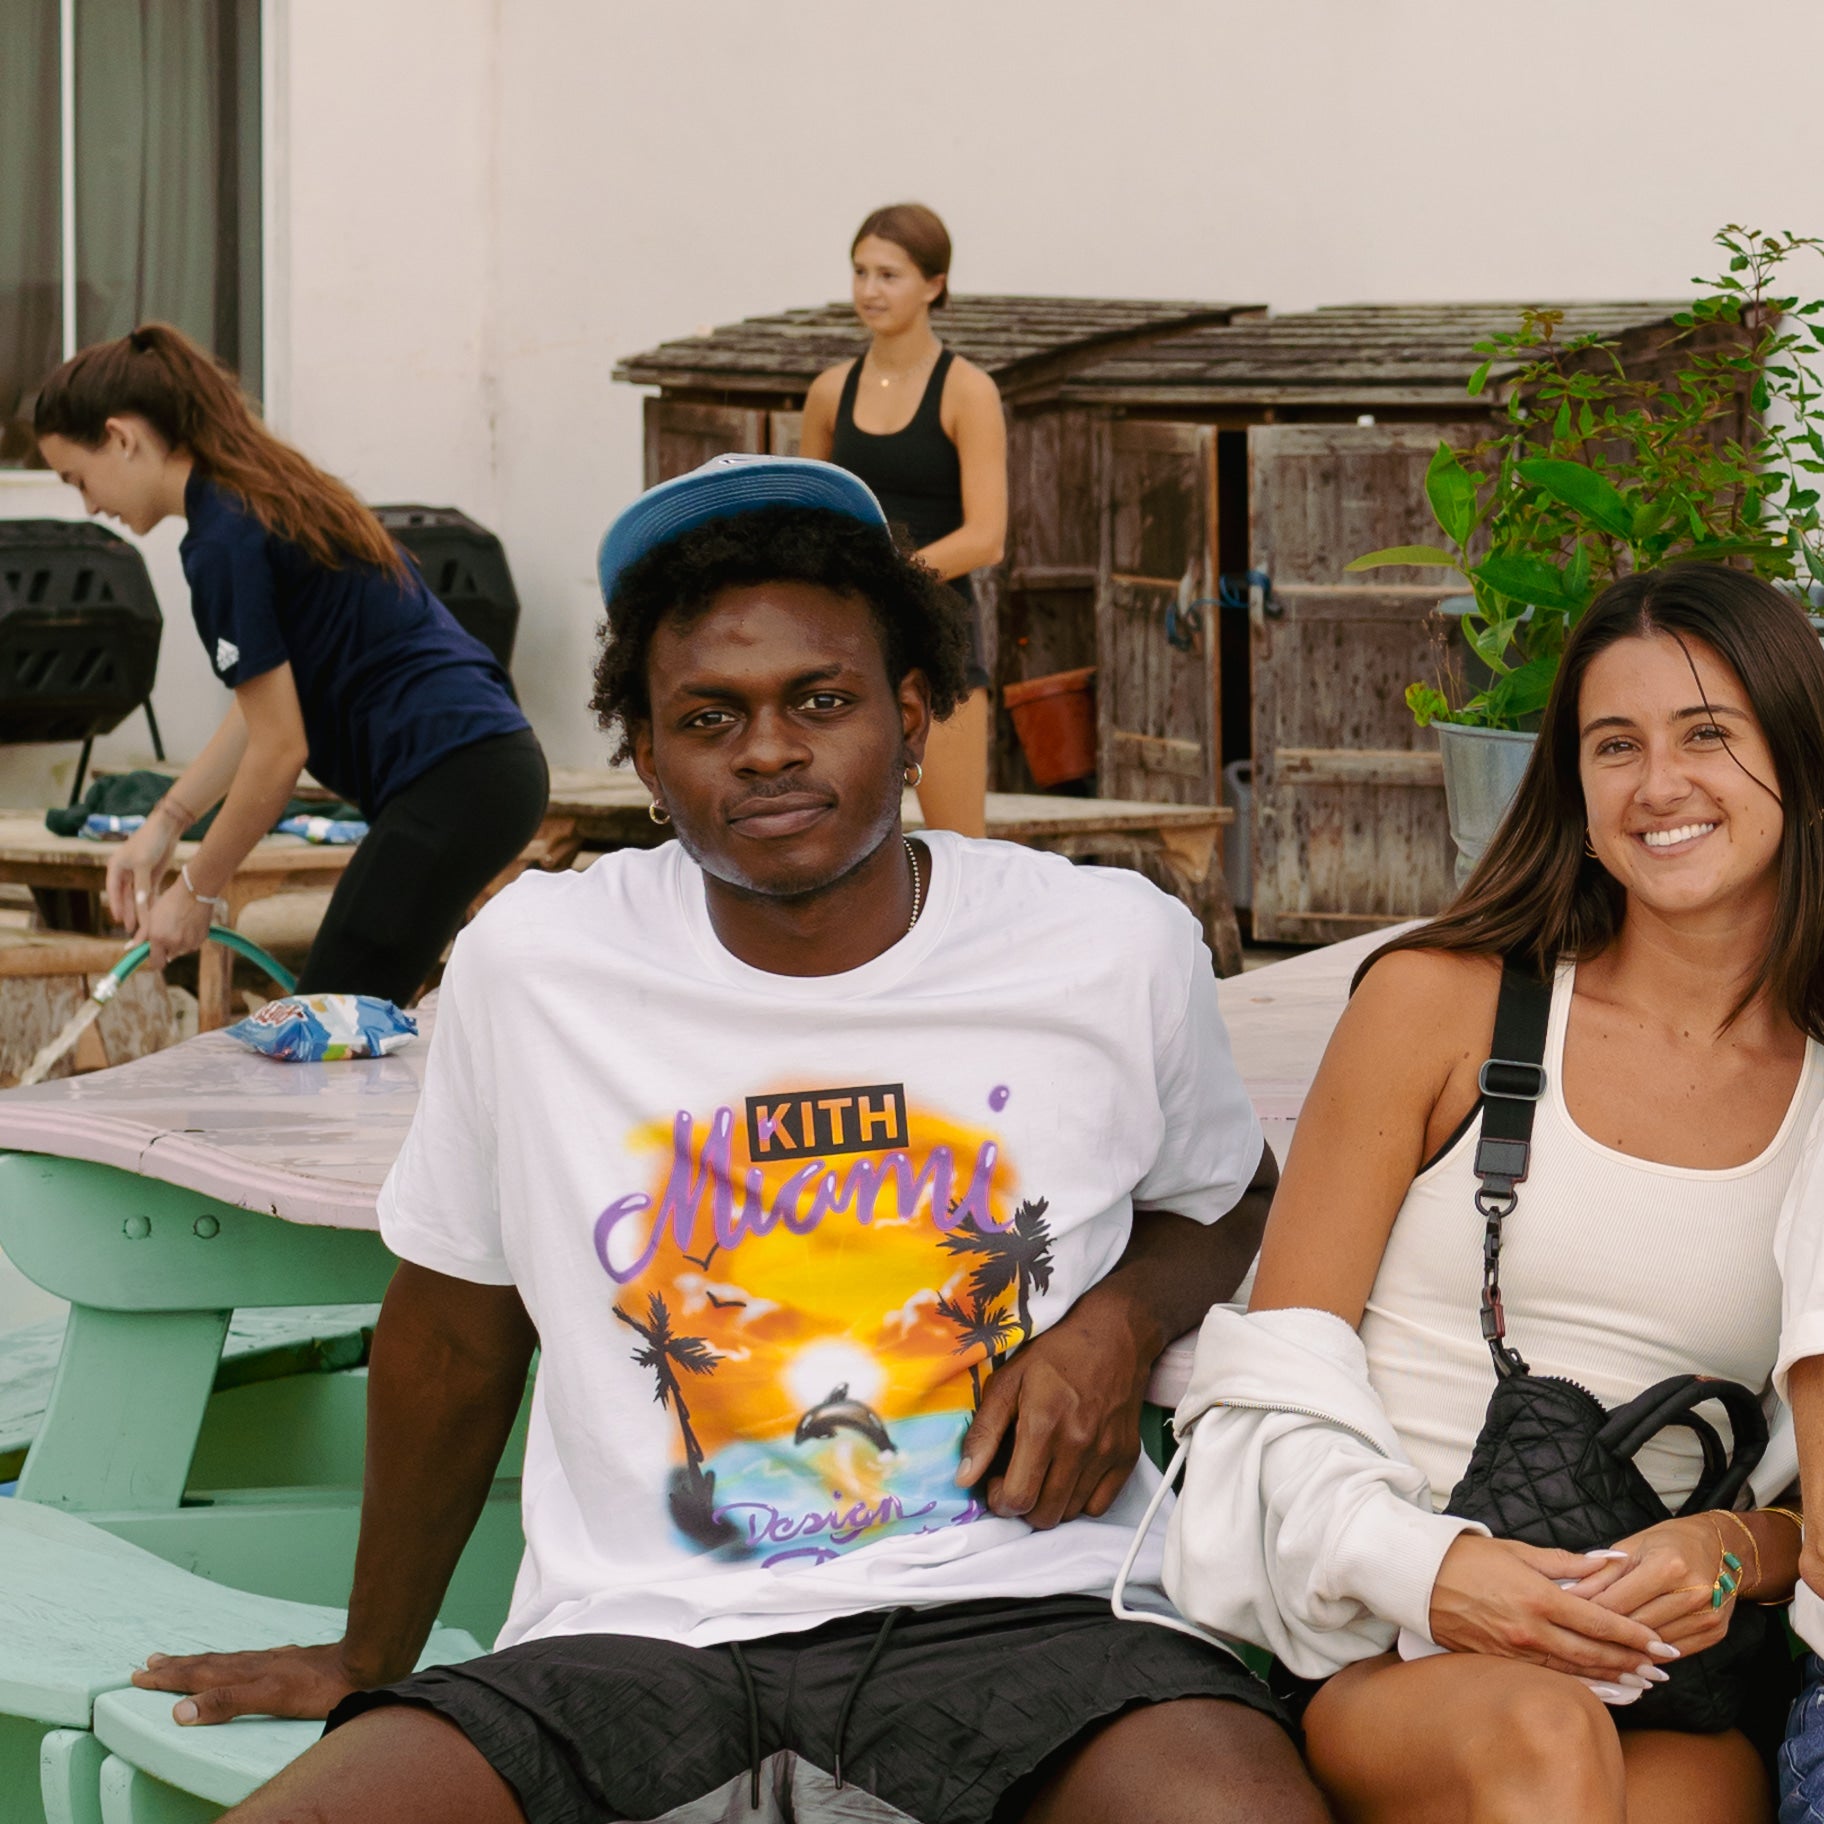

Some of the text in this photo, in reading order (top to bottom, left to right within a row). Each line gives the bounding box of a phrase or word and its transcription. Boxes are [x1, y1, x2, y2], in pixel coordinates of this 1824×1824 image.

[755, 1092, 898, 1153] KITH
[594, 1085, 1013, 1284] Miami
[712, 1490, 938, 1546] Design
